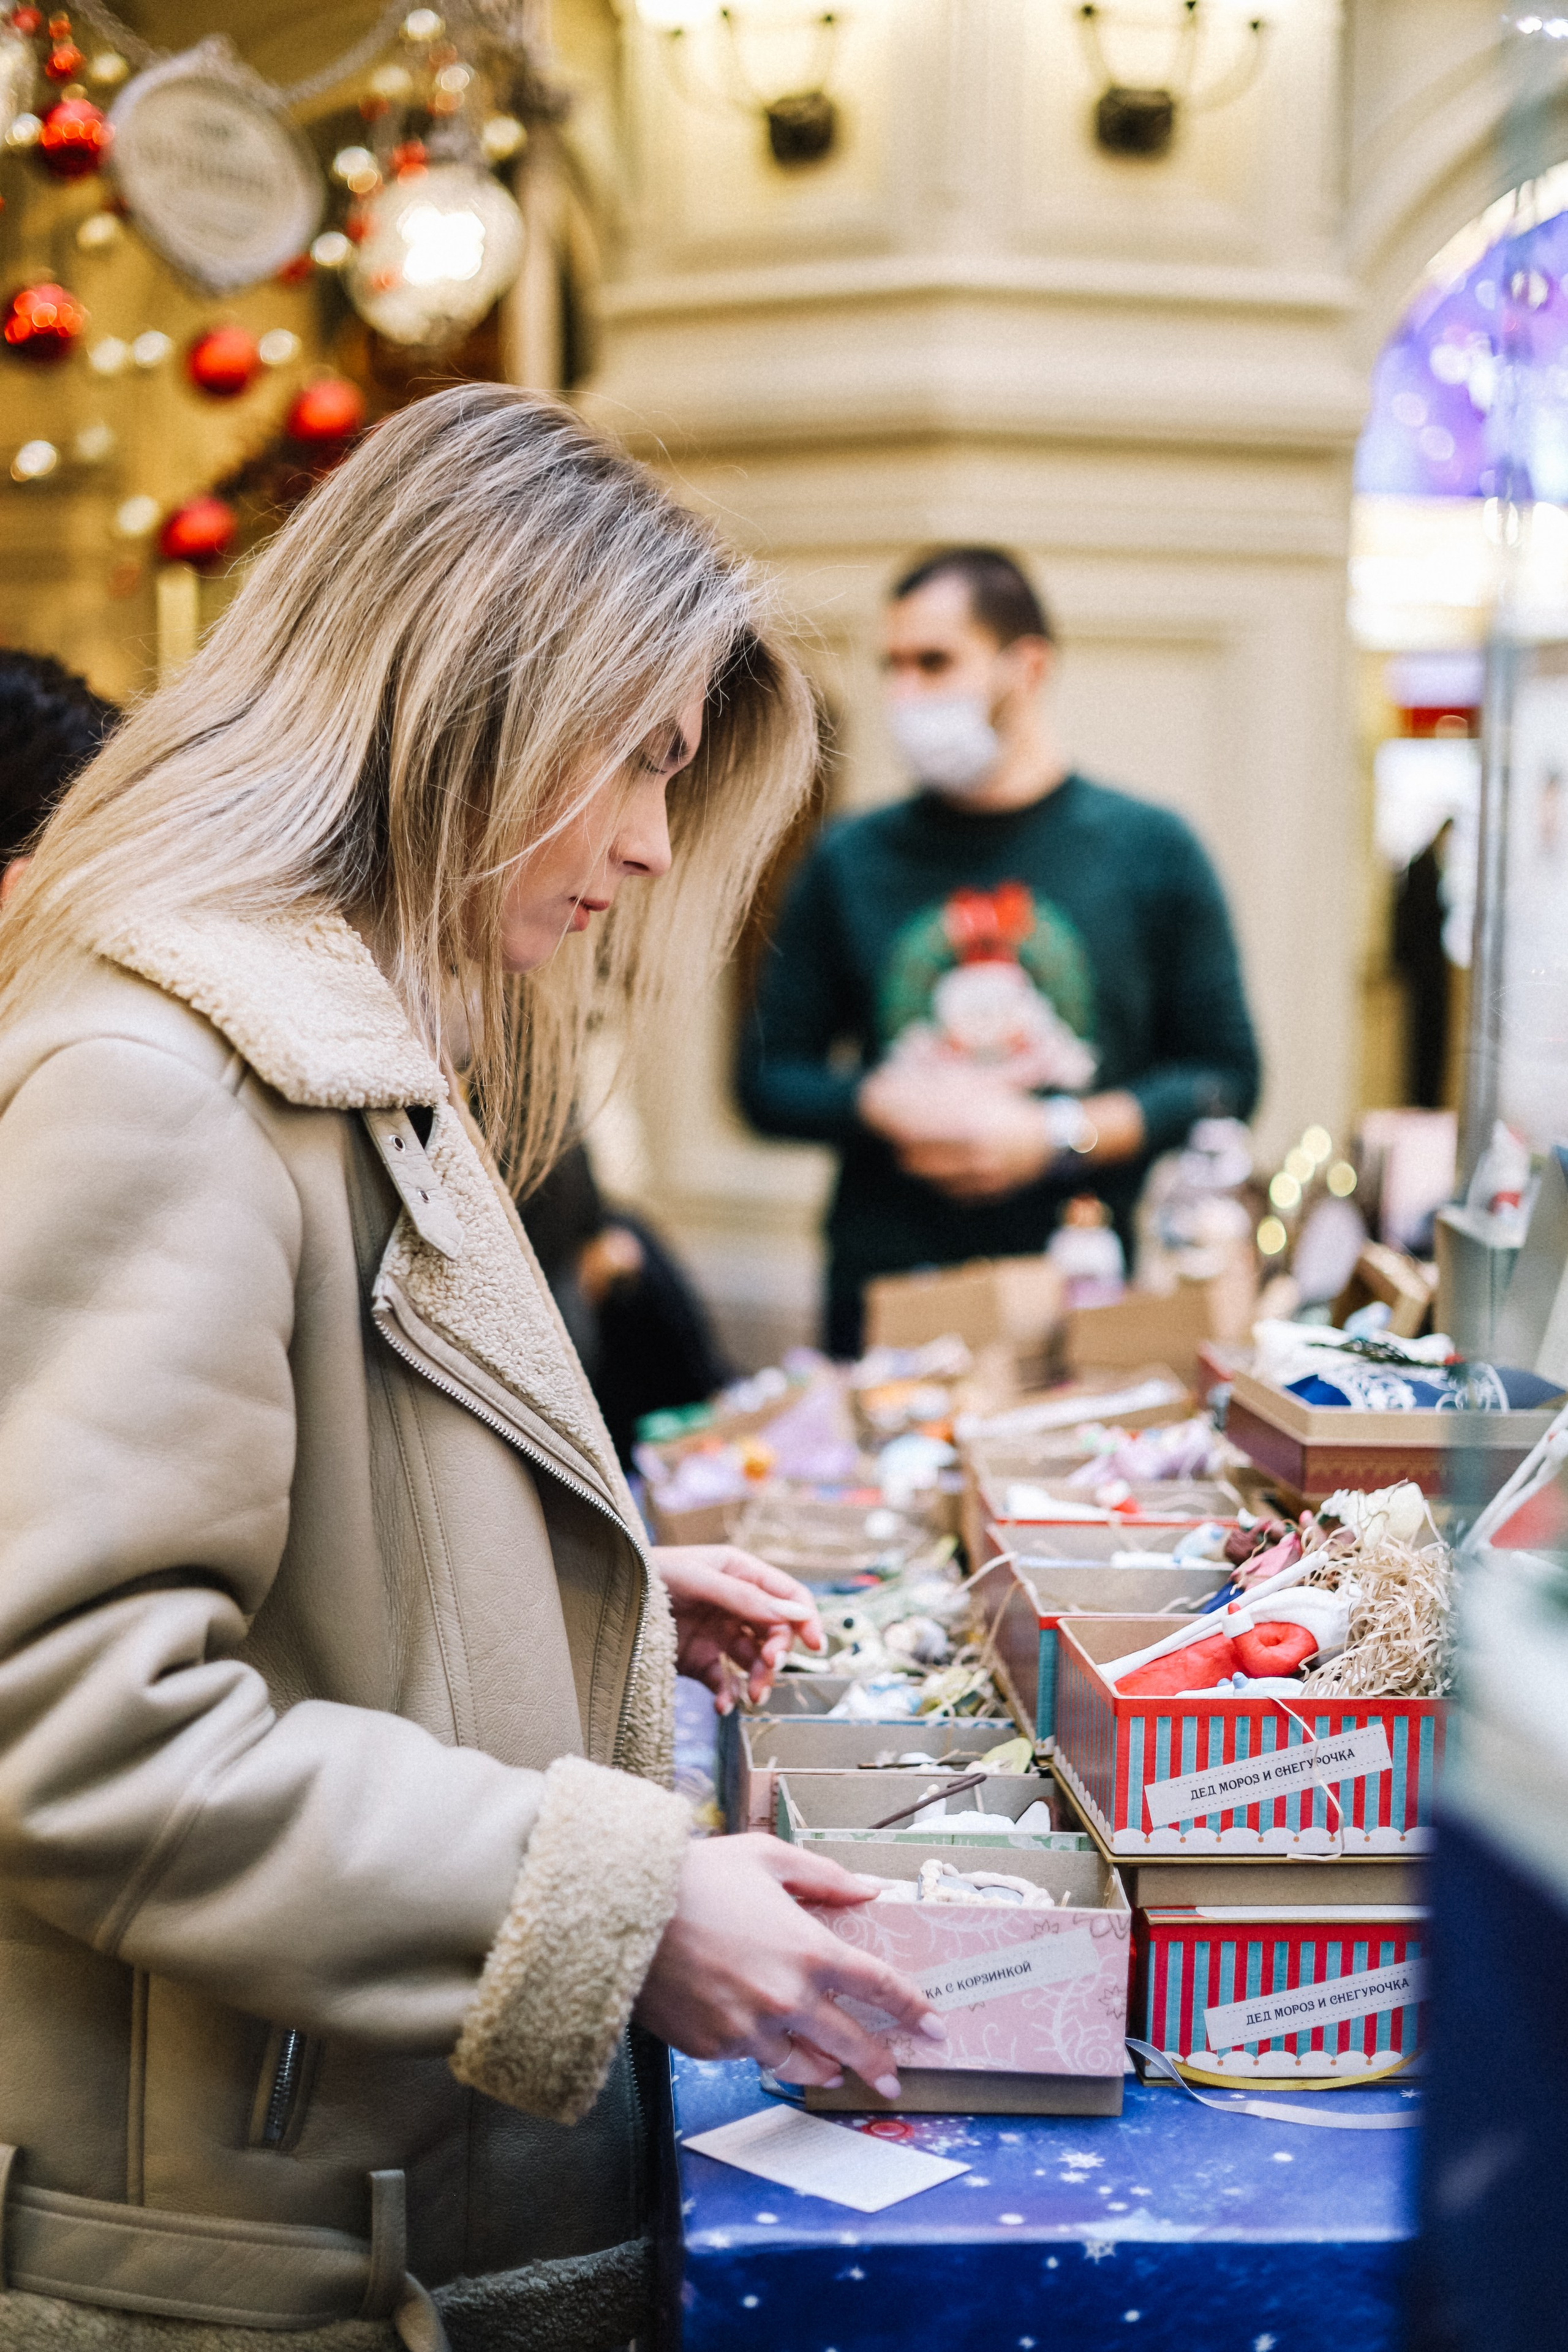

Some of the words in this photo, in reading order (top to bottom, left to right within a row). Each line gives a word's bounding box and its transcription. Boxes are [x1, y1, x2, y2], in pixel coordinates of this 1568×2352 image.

[1190, 1785, 1216, 1801] ДЕД
[1219, 1773, 1260, 1794] МОРОЗ
[1263, 1770, 1272, 1781] И
[1275, 1749, 1355, 1777] СНЕГУРОЧКА
[945, 1983, 954, 1992] С
[957, 1961, 1032, 1990] КОРЗИНКОЙ
[1246, 2011, 1272, 2026] ДЕД
[1274, 2000, 1315, 2019] МОРОЗ
[1318, 1997, 1327, 2008] И
[1330, 1978, 1409, 2005] СНЕГУРОЧКА
